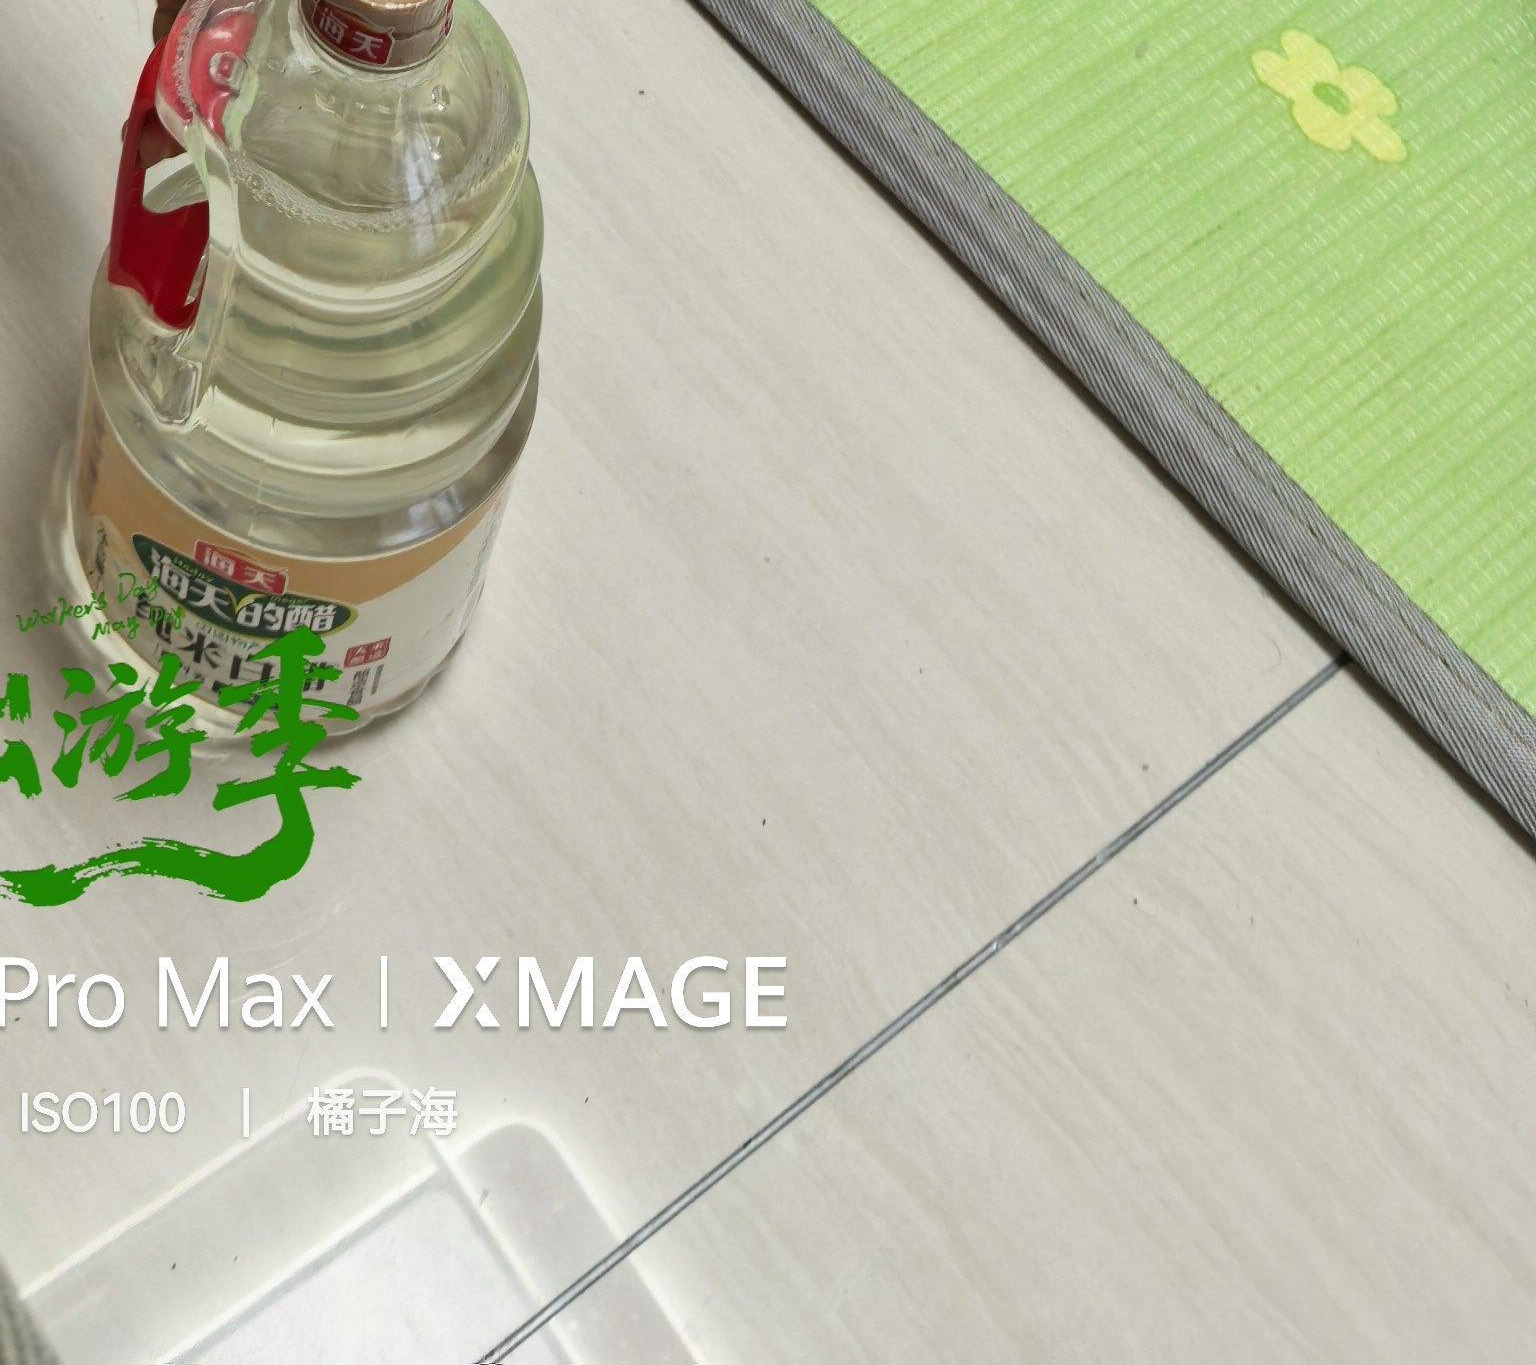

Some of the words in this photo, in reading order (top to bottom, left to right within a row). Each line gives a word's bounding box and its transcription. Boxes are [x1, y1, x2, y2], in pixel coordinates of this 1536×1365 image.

[319, 7, 385, 60] 海天
[150, 547, 337, 633] 海天的醋
